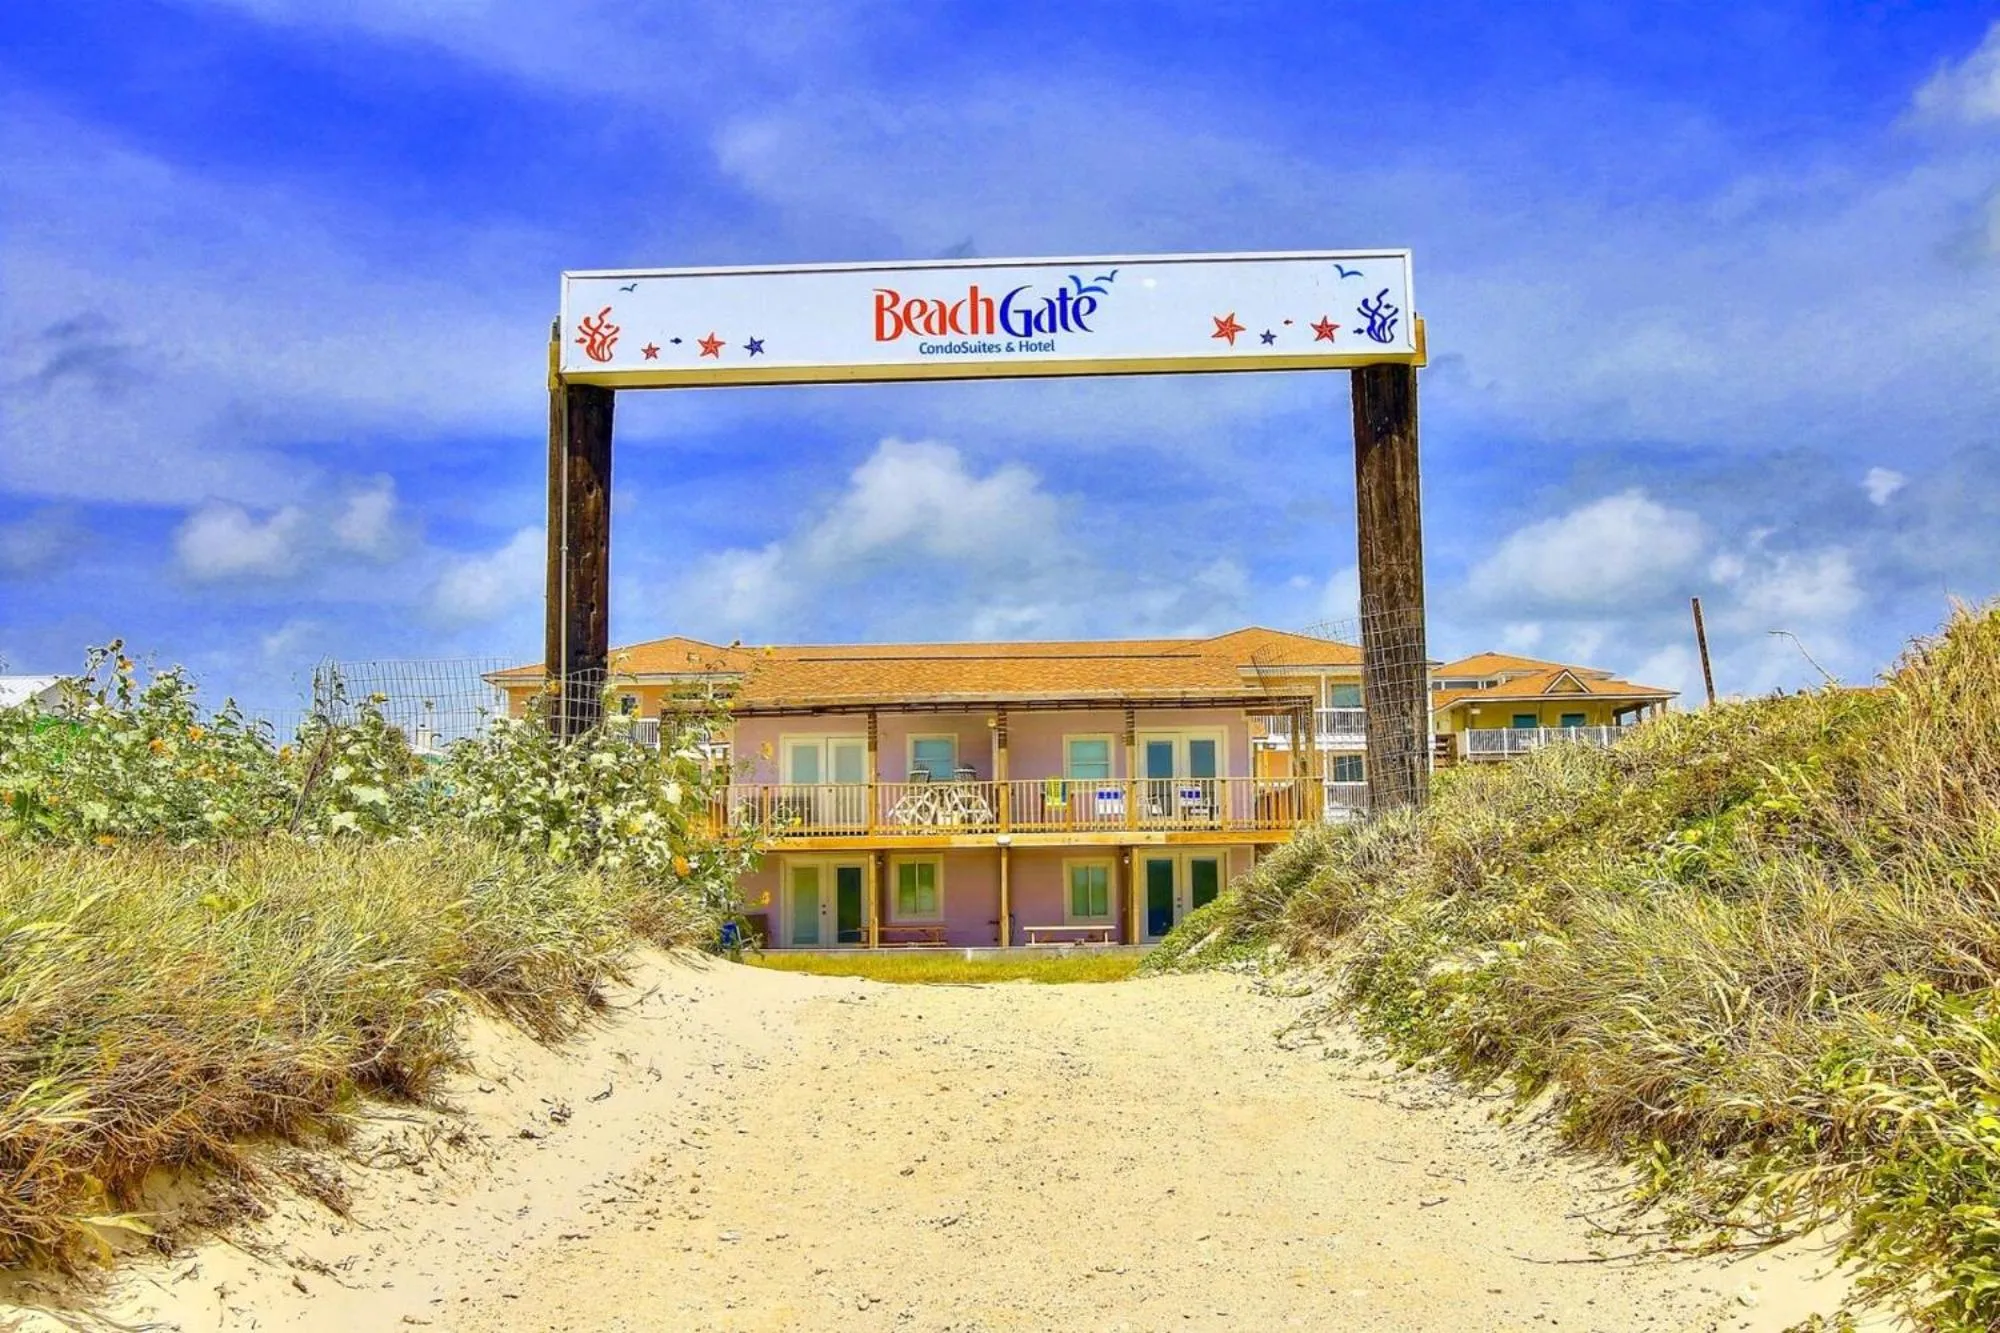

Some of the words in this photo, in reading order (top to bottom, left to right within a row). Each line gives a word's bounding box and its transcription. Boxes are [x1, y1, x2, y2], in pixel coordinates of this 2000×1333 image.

[919, 341, 1001, 355] CondoSuites
[1005, 343, 1015, 352] &
[1019, 340, 1055, 352] Hotel
